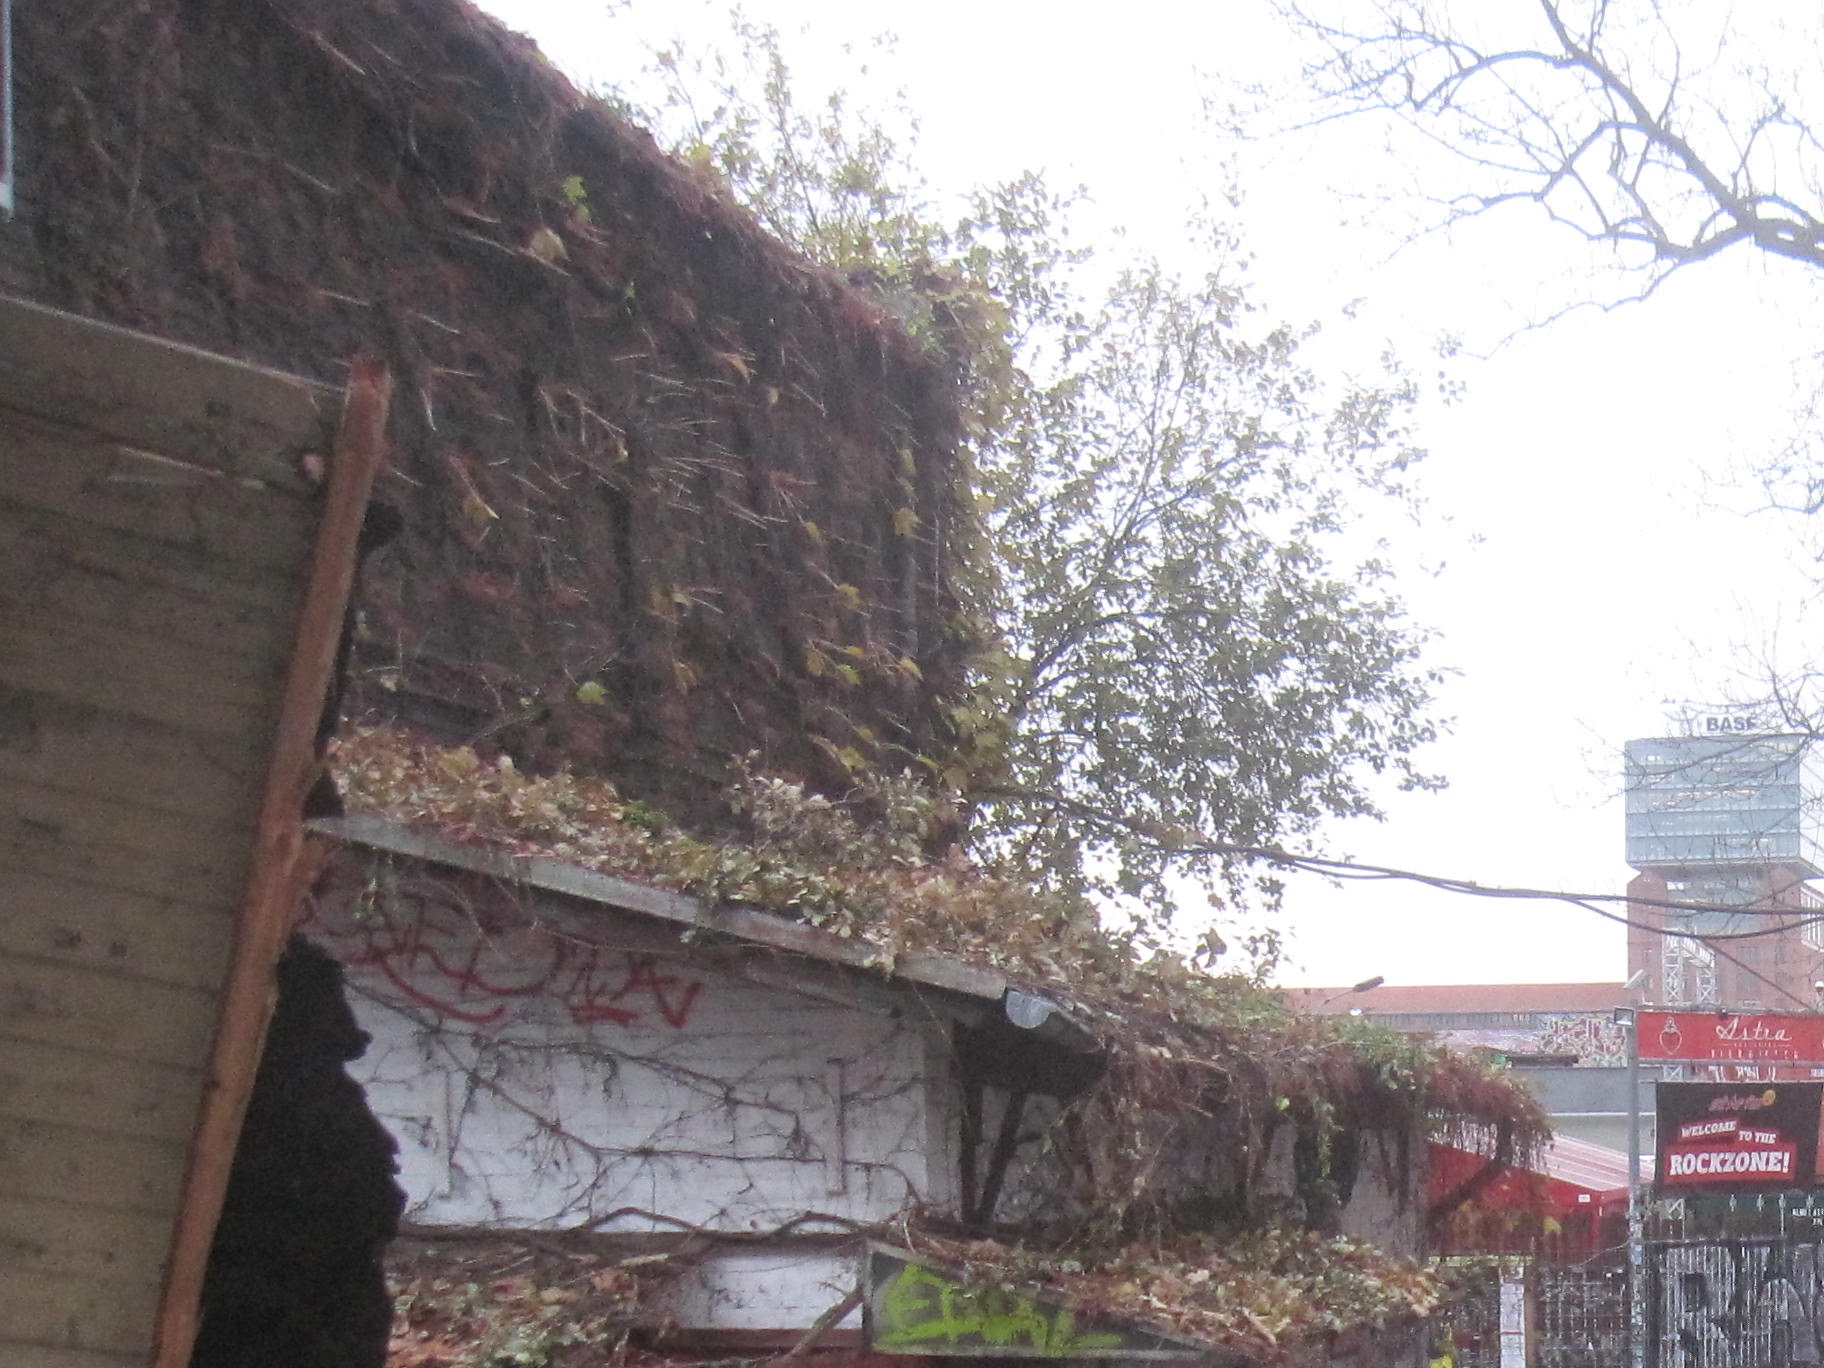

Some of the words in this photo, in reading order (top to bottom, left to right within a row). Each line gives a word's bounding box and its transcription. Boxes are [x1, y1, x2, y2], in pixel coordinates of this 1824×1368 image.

[1715, 1016, 1793, 1042] Astra
[1681, 1120, 1737, 1139] WELCOME
[1738, 1130, 1753, 1142] TO
[1755, 1131, 1777, 1144] THE
[1669, 1151, 1790, 1177] ROCKZONE!
